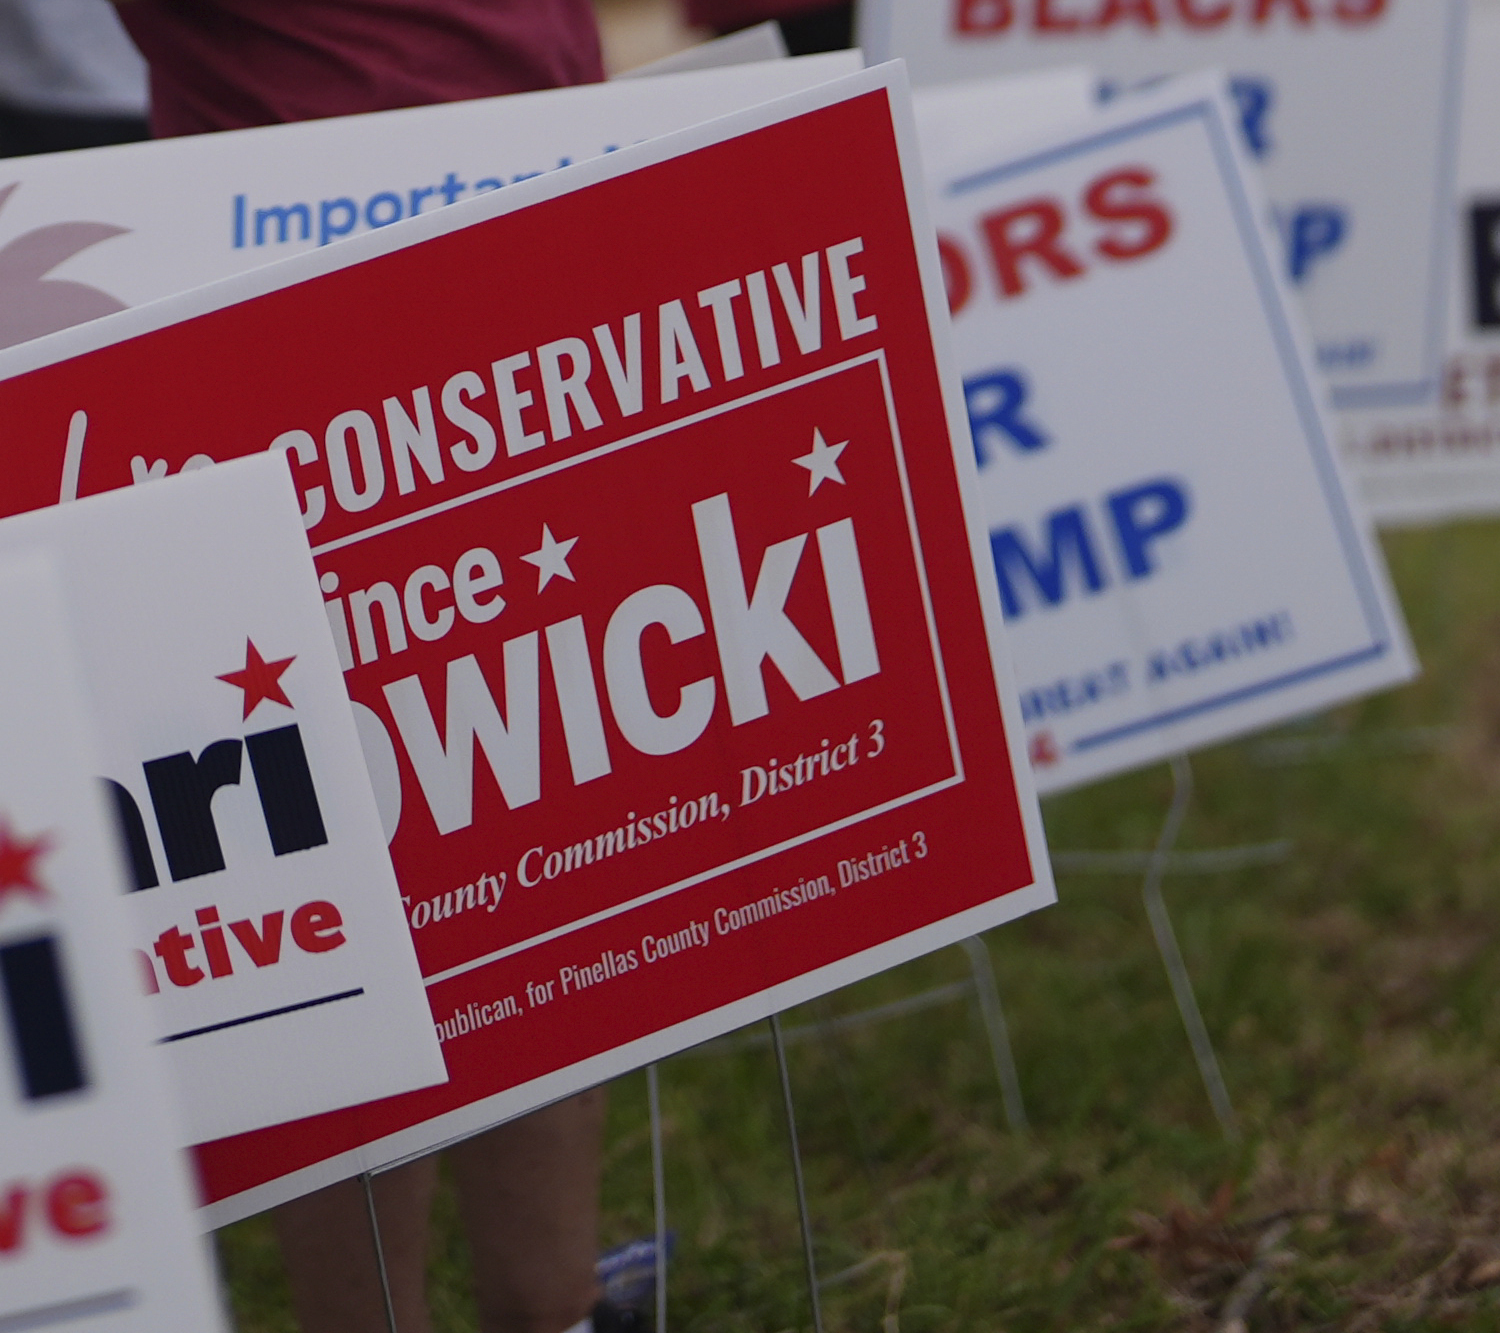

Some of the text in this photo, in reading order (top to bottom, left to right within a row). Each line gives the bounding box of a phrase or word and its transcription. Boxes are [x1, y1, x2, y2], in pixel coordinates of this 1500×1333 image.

[266, 236, 880, 533] CONSERVATIVE
[318, 546, 507, 674] ince
[350, 491, 882, 848] wicki
[516, 787, 733, 889] Commission,
[738, 734, 861, 809] District
[867, 718, 886, 759] 3
[134, 898, 348, 996] tive
[434, 830, 930, 1045] publican, for Pinellas County Commission, District 3
